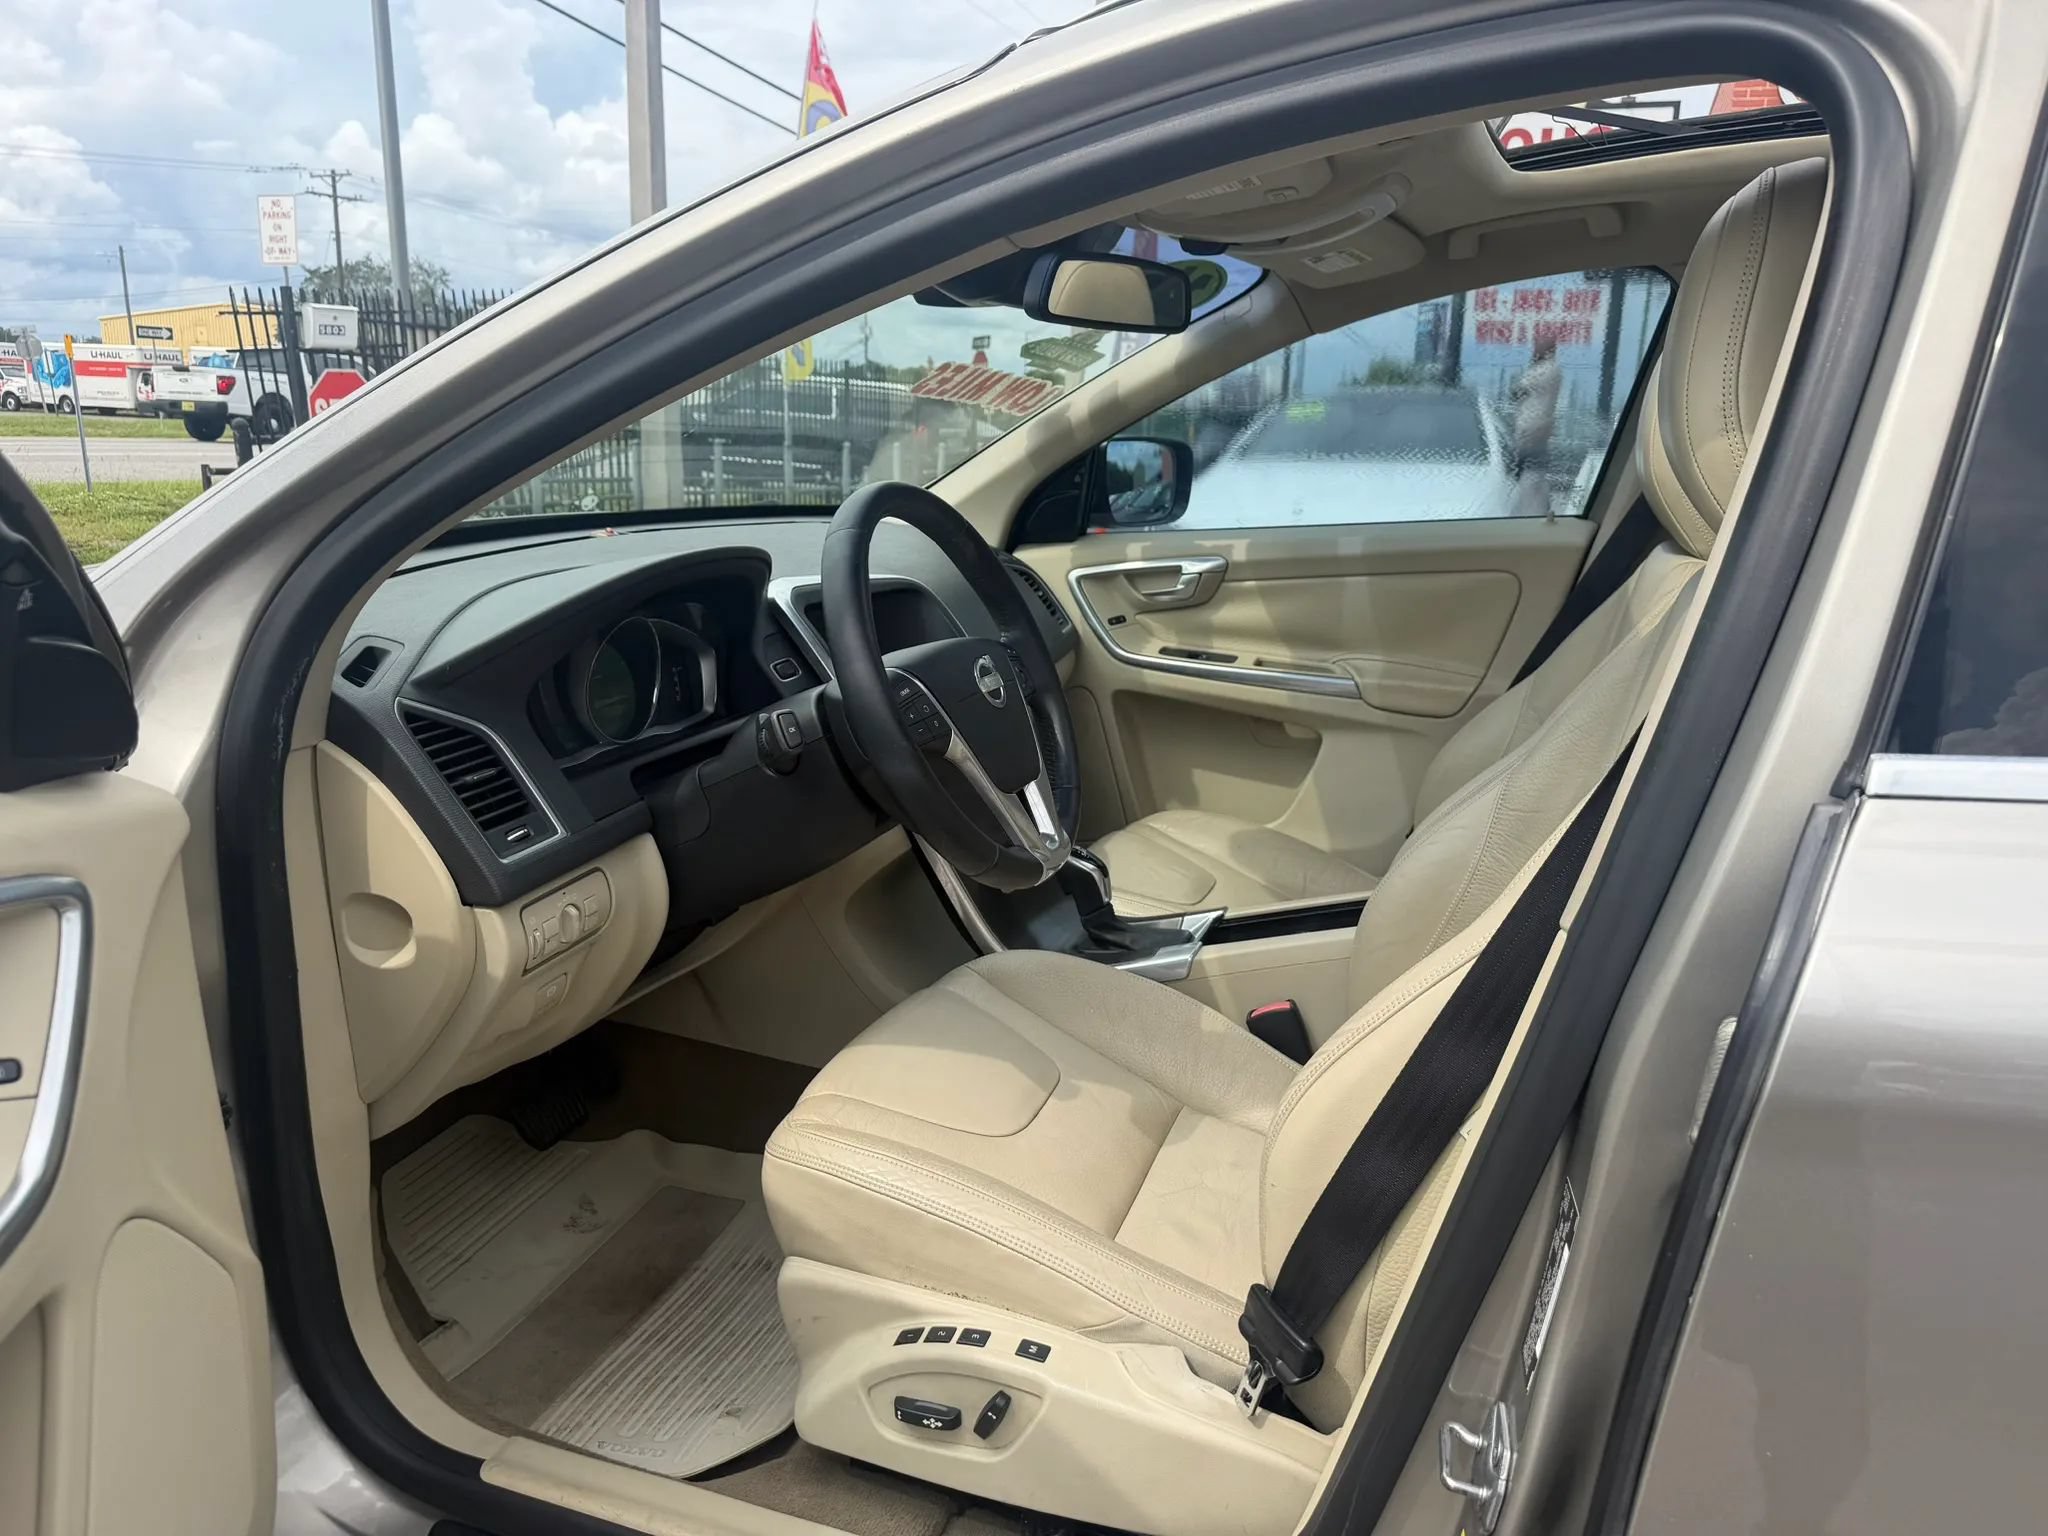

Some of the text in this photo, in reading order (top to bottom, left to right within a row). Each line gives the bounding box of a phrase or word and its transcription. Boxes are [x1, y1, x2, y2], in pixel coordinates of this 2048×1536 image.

[271, 199, 281, 208] NO
[263, 211, 292, 220] PARKING
[272, 223, 282, 232] ON
[269, 235, 288, 244] RIGHT
[90, 351, 123, 359] U-HAUL
[144, 352, 181, 361] UHAUL
